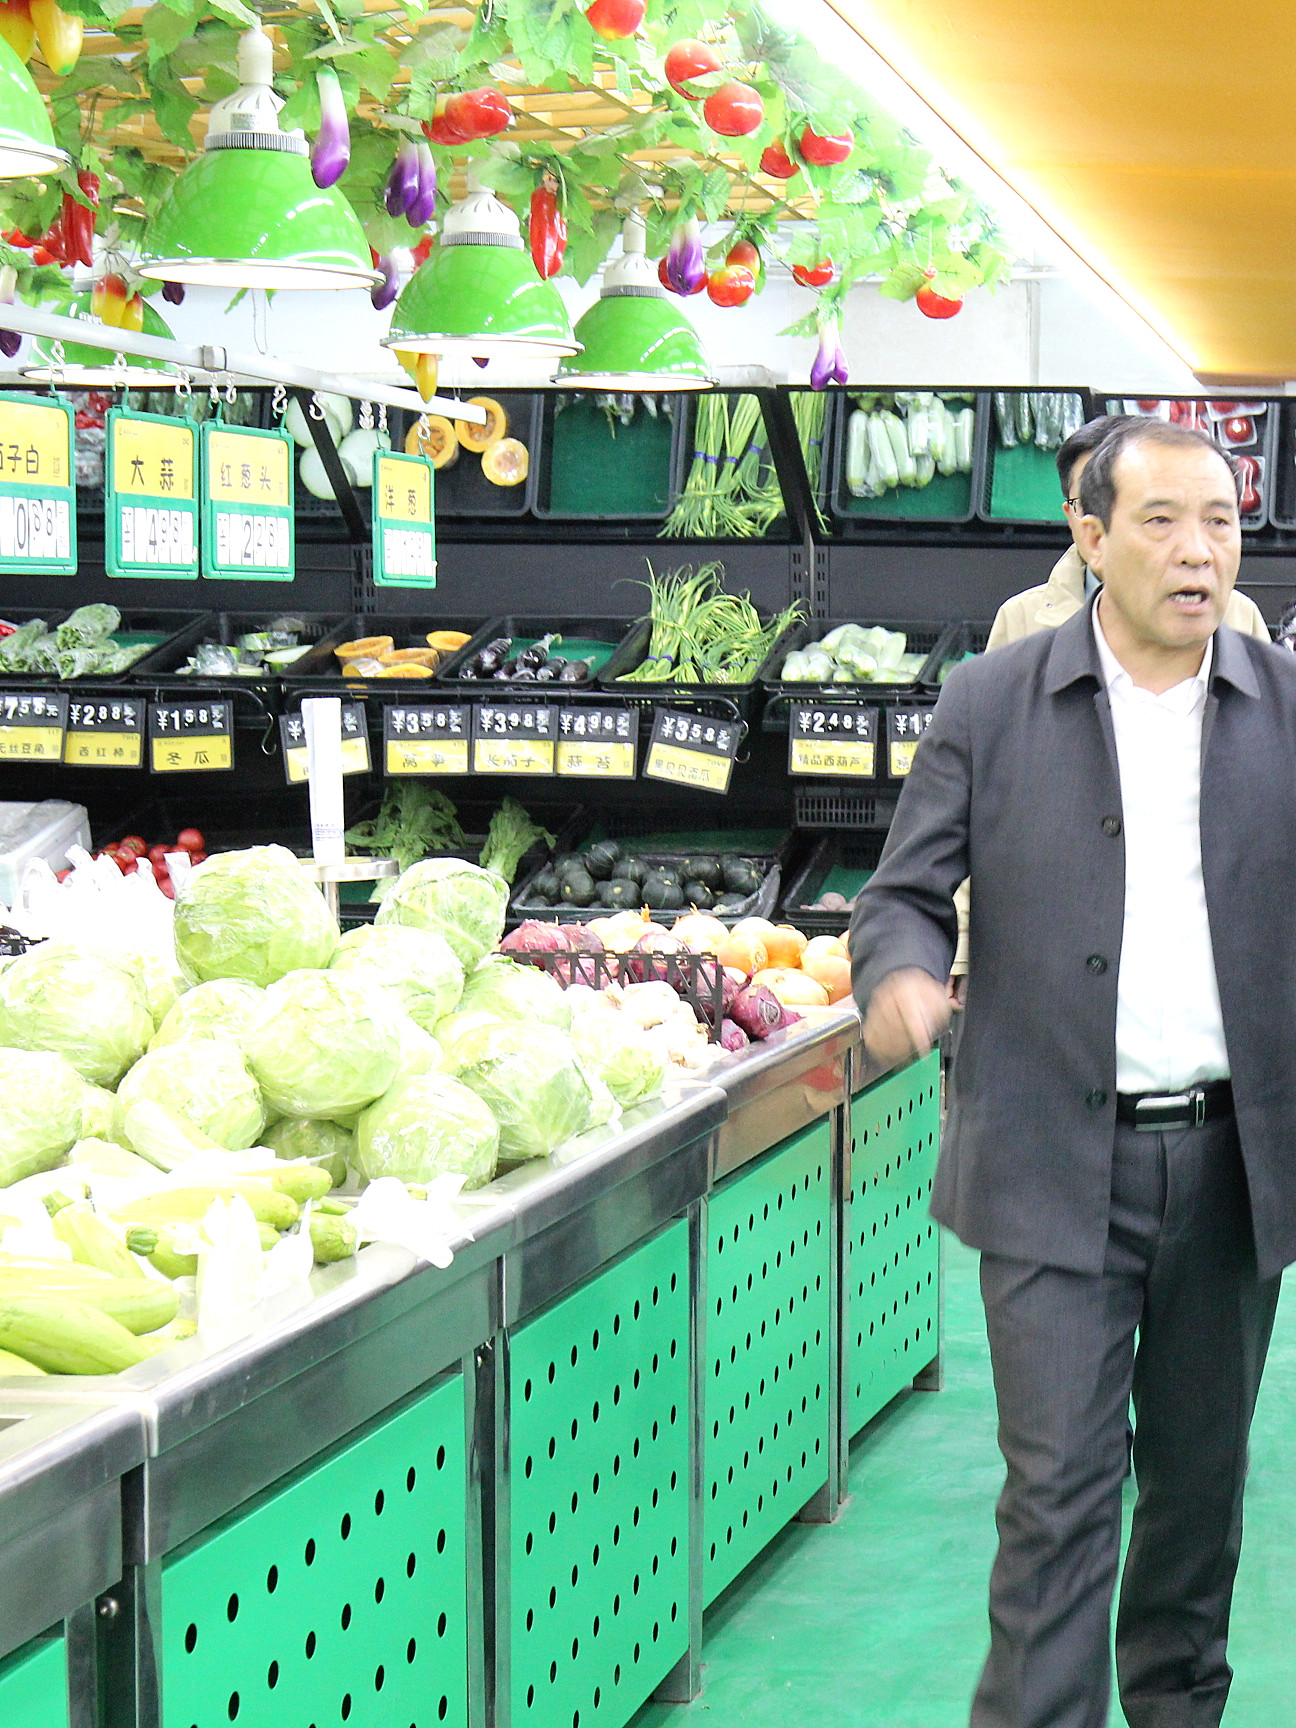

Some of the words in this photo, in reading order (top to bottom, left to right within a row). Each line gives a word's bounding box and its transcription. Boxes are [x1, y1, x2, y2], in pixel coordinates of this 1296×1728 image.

[131, 454, 174, 491] 大蒜
[221, 462, 272, 492] 红葱头
[385, 484, 417, 516] 洋葱
[79, 746, 124, 758] 西红柿
[166, 750, 209, 766] 冬瓜
